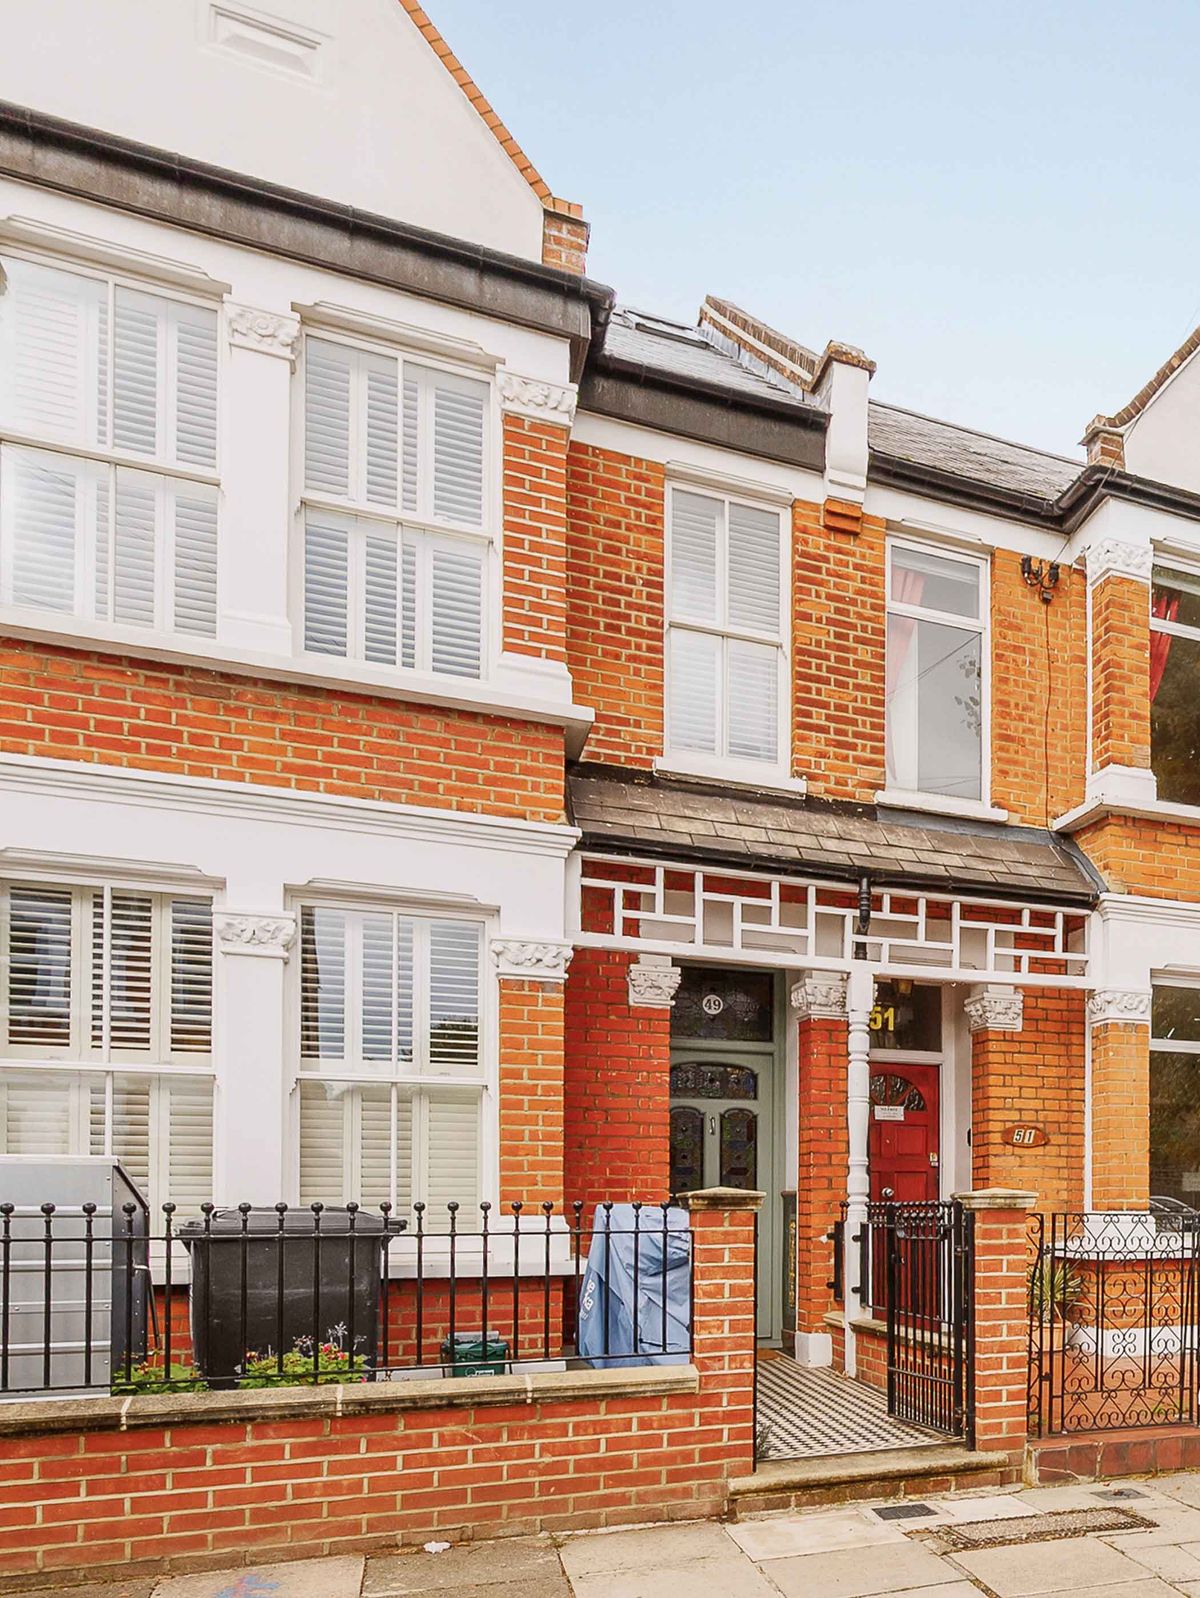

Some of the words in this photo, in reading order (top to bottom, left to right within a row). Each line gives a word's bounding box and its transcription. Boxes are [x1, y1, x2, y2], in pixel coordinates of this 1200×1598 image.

[705, 998, 721, 1011] 49
[869, 1005, 895, 1032] 51
[1014, 1129, 1033, 1143] 51
